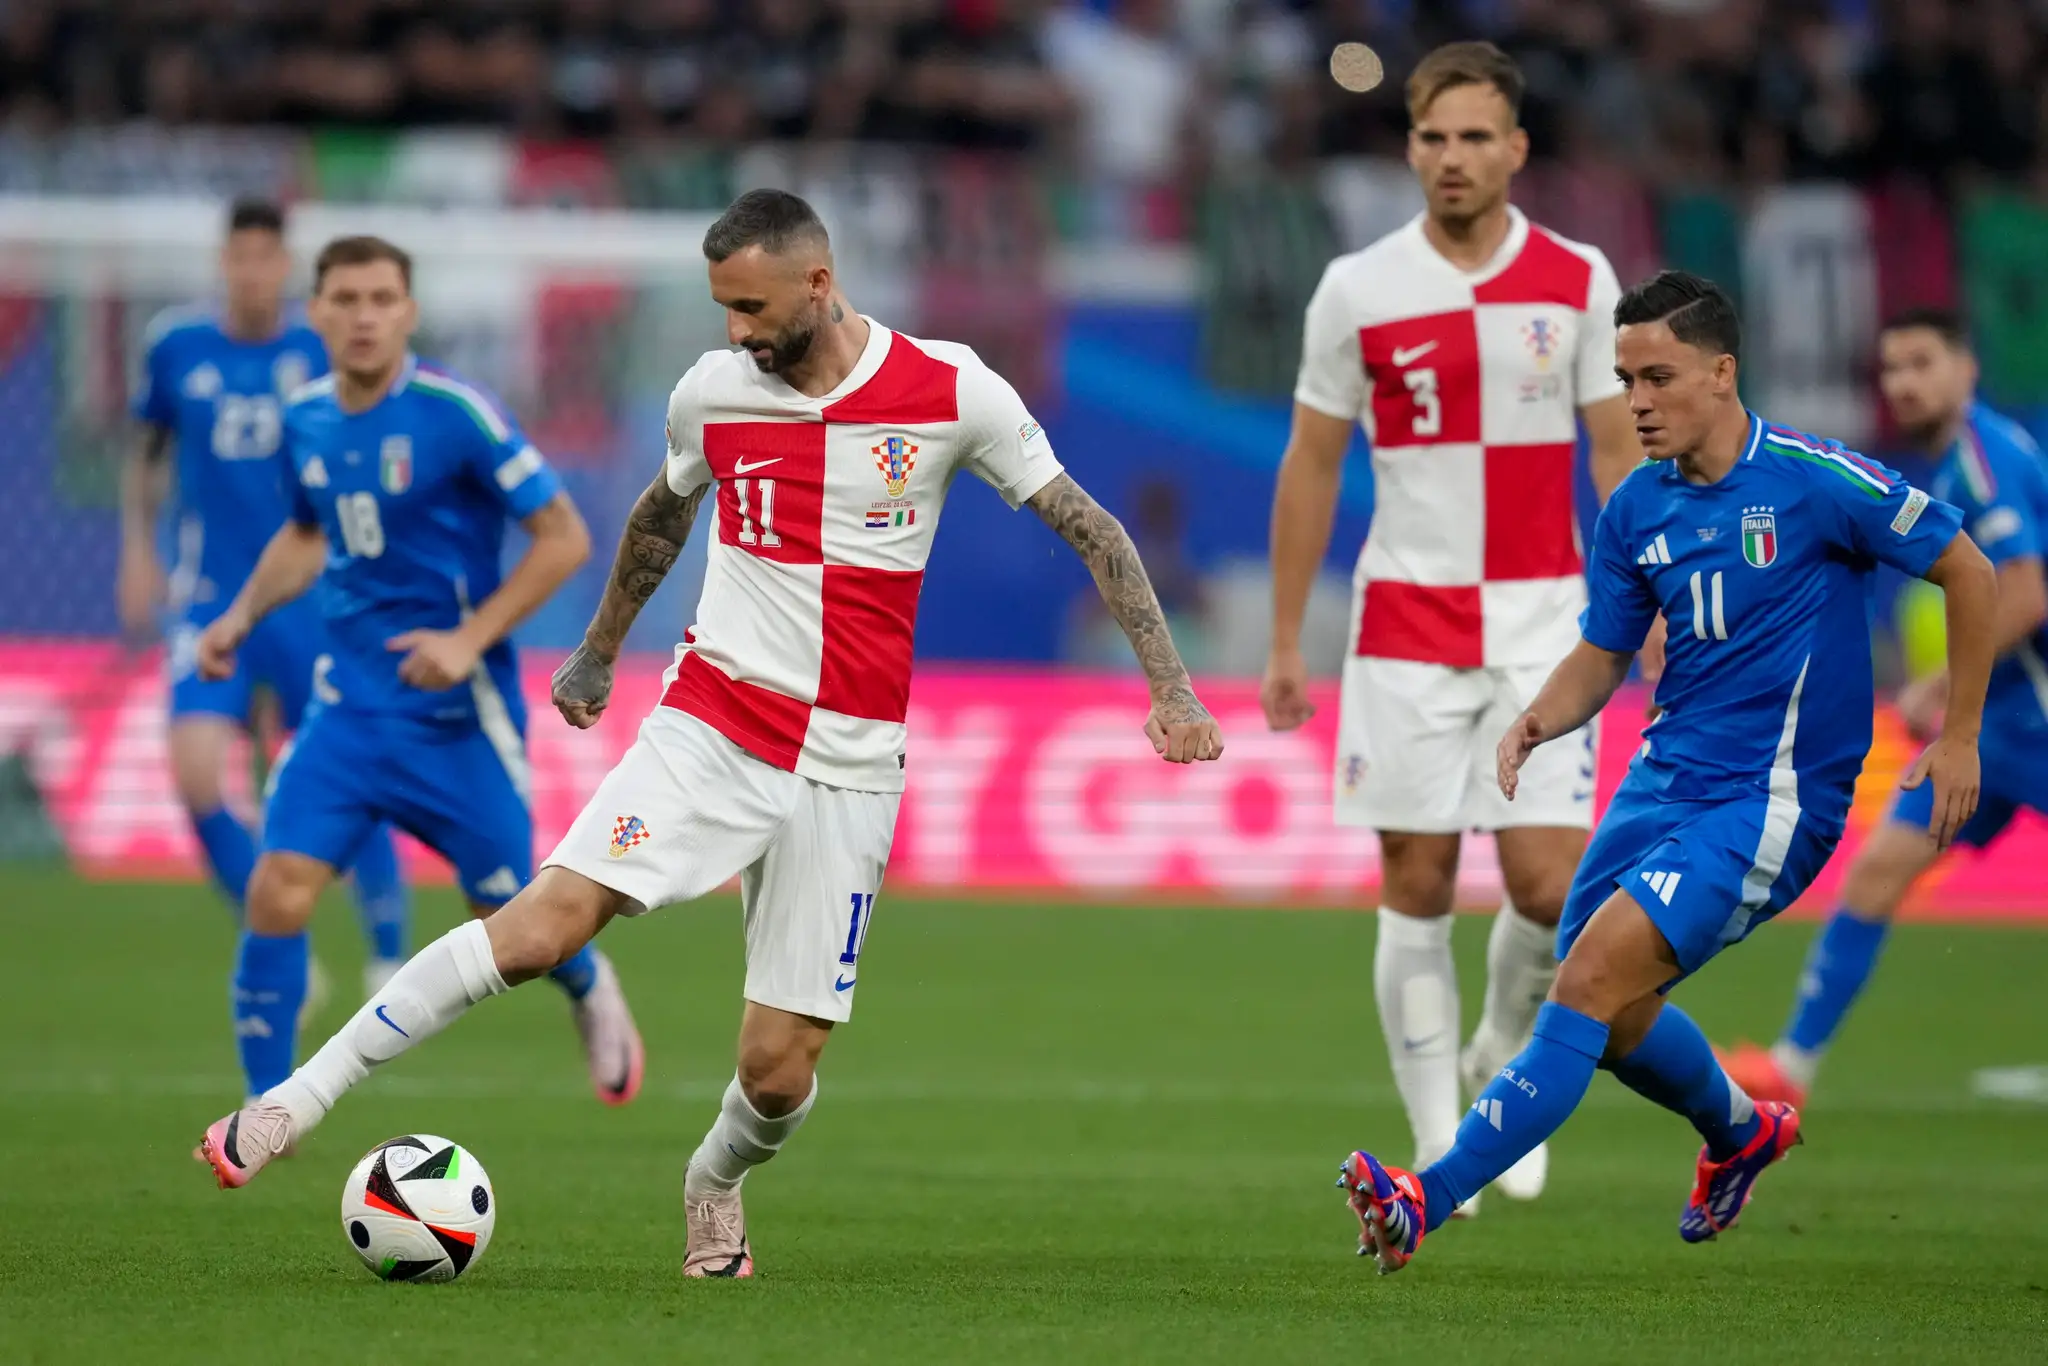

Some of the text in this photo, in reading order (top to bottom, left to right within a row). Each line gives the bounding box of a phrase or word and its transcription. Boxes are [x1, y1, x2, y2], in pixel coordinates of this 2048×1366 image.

[1403, 368, 1441, 436] 3
[335, 491, 385, 558] 18
[735, 479, 781, 547] 11
[1744, 519, 1772, 530] ITALIA
[1690, 571, 1728, 640] 11
